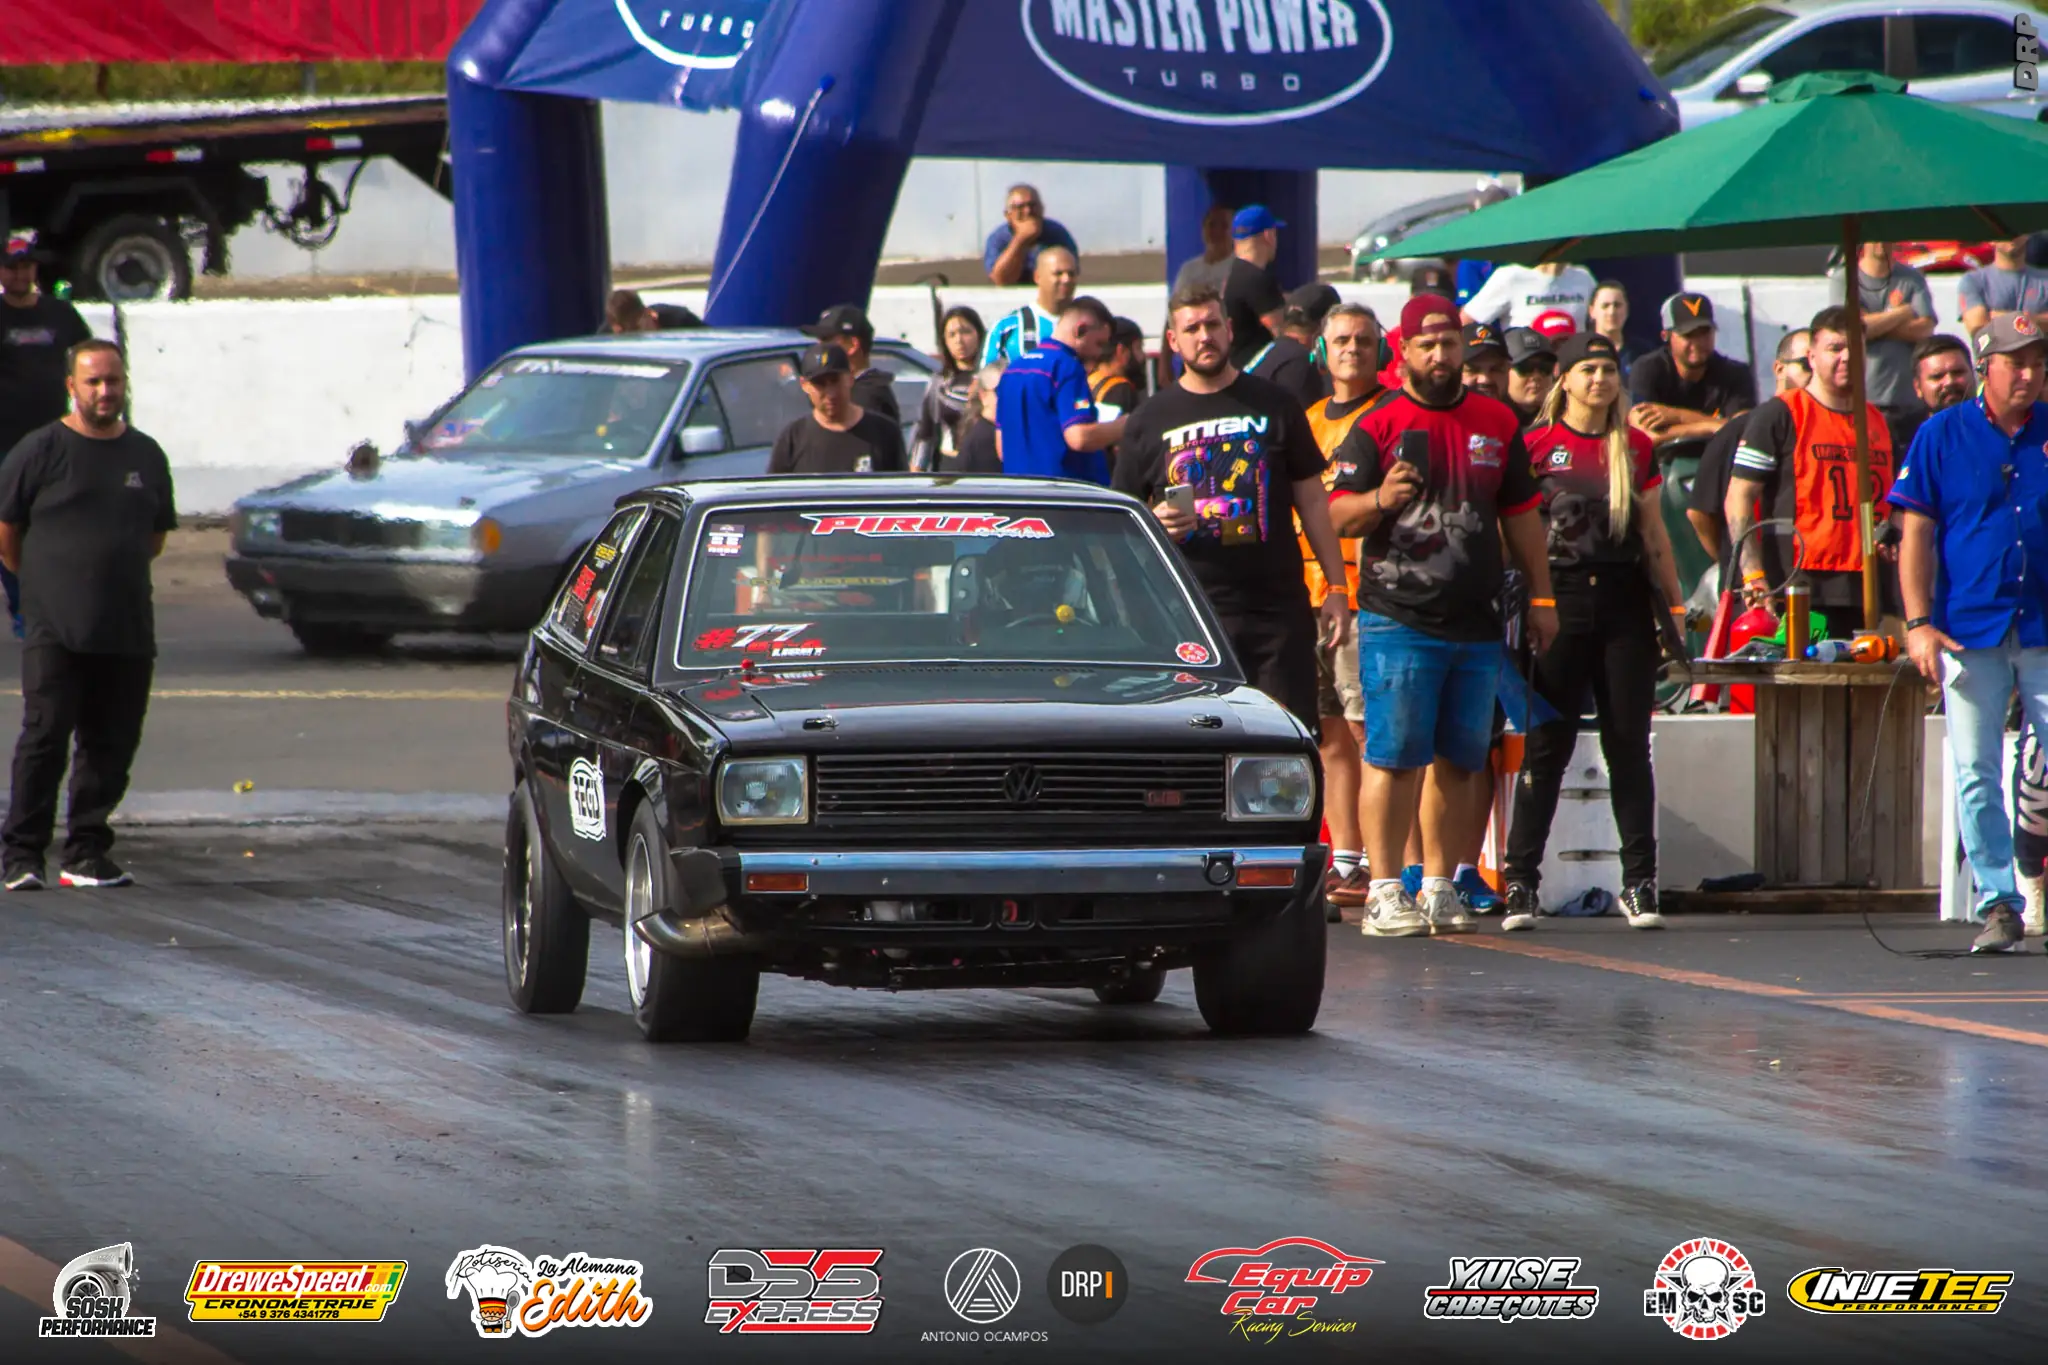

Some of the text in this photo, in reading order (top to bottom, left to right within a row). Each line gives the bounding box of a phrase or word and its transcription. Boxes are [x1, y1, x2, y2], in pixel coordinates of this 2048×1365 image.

[1123, 67, 1301, 91] TURBO
[1552, 452, 1568, 464] 67
[811, 514, 1054, 537] PIRUKA
